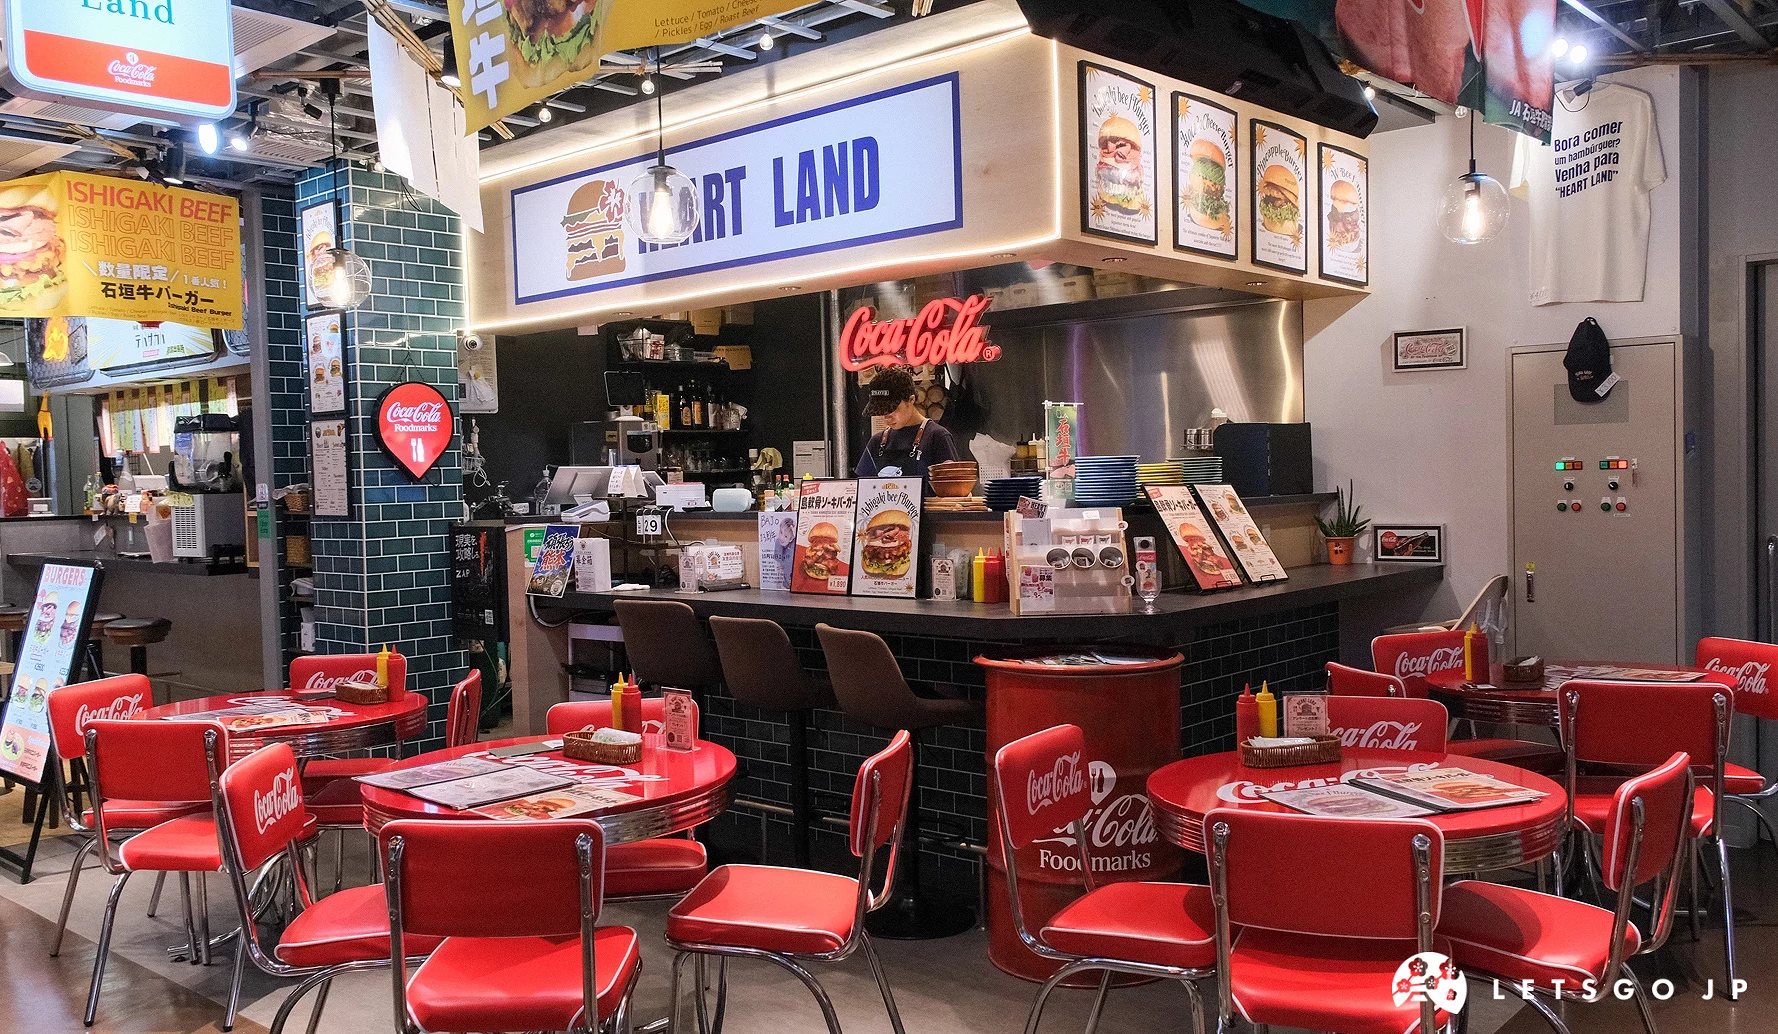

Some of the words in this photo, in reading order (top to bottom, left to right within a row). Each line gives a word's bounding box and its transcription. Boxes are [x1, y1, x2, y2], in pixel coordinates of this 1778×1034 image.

[654, 15, 689, 28] Lettuce
[697, 7, 725, 20] Tomato
[662, 25, 693, 38] Pickles
[700, 20, 713, 32] Egg
[720, 13, 741, 25] Roast
[741, 5, 760, 18] Beef
[107, 60, 157, 82] Coca-Cola
[1509, 99, 1521, 117] JA
[1554, 135, 1580, 152] Bora
[1583, 121, 1623, 143] comer
[1554, 155, 1567, 166] um
[1555, 160, 1590, 183] Venha
[1593, 152, 1619, 171] para
[66, 180, 174, 214] ISHIGAKI
[180, 197, 233, 224] BEEF
[638, 165, 747, 255] HART
[772, 136, 881, 228] LAND
[67, 205, 175, 238] ISHIGAKI
[180, 220, 234, 247] BEEF
[69, 230, 176, 262] ISHIGAKI
[181, 243, 235, 270] BEEF
[98, 260, 169, 281] 数量限定
[100, 281, 215, 306] 石垣牛バーガー
[167, 302, 190, 313] Ishigaki
[191, 304, 207, 314] Beef
[209, 306, 232, 317] Burger
[839, 294, 994, 372] Coca-Cola
[386, 401, 443, 424] Coca-Cola
[394, 423, 438, 432] Foodmarks
[1055, 419, 1071, 467] 石垣牛
[861, 491, 886, 517] Ishigaki
[643, 519, 659, 532] 29
[540, 549, 567, 571] 熊本
[44, 565, 87, 587] BURGERS
[1395, 646, 1465, 680] Coca-Cola
[305, 669, 380, 691] Coca-C
[75, 692, 144, 736] Coca-Cola
[1328, 719, 1421, 751] ca-Cola
[1027, 750, 1084, 815] Coca-Cola
[254, 767, 299, 835] Coca-Cola
[1032, 793, 1159, 848] -Cola
